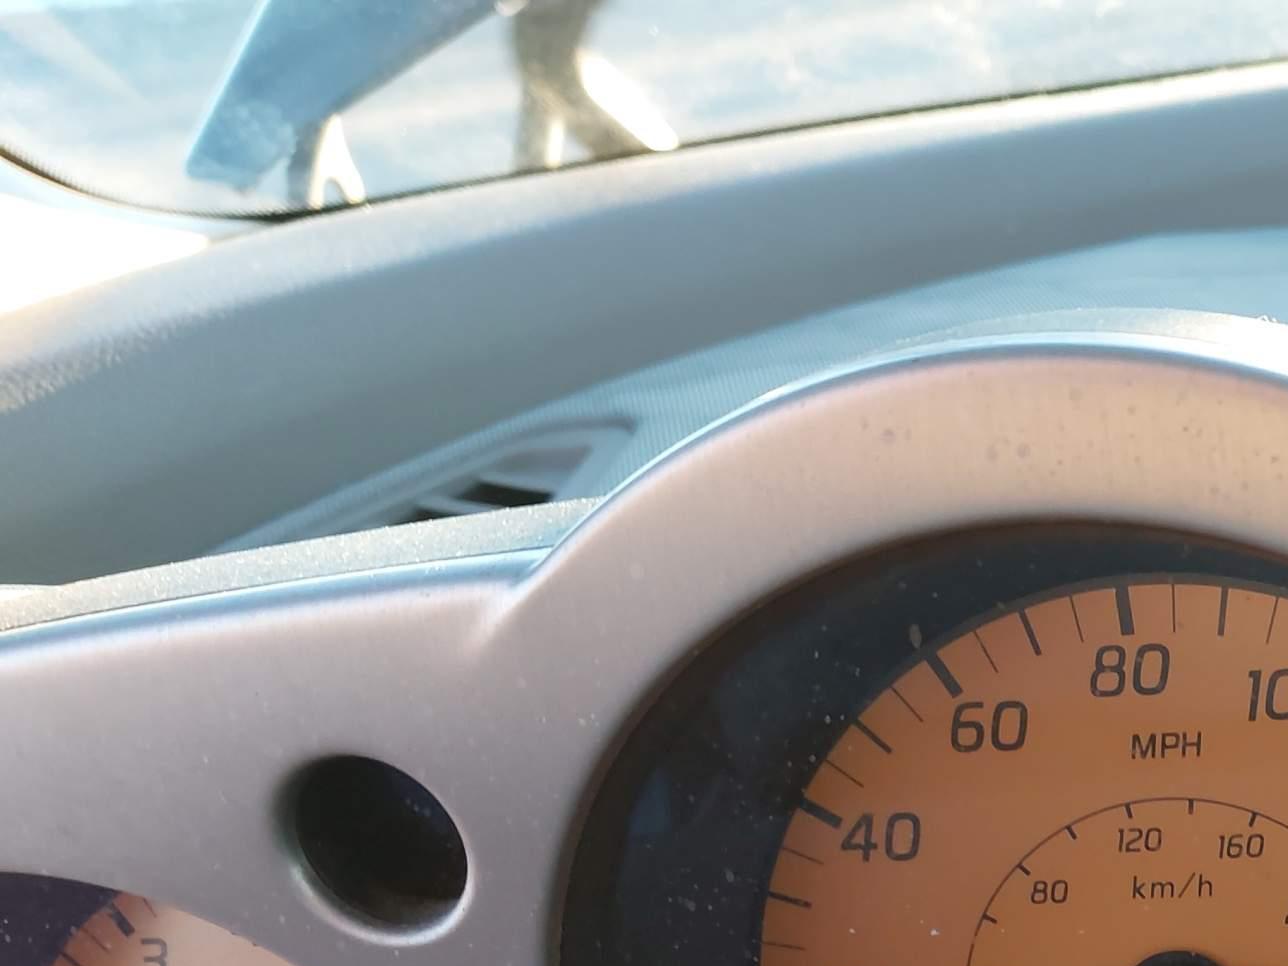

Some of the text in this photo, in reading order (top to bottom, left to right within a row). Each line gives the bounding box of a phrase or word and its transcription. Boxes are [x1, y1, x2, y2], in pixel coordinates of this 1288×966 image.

[1089, 643, 1170, 698] 80
[949, 700, 1029, 753] 60
[1130, 731, 1203, 760] MPH
[840, 812, 921, 862] 40
[1116, 826, 1163, 853] 120
[1218, 834, 1266, 860] 160
[1029, 879, 1069, 905] 80
[1131, 872, 1214, 900] km/h
